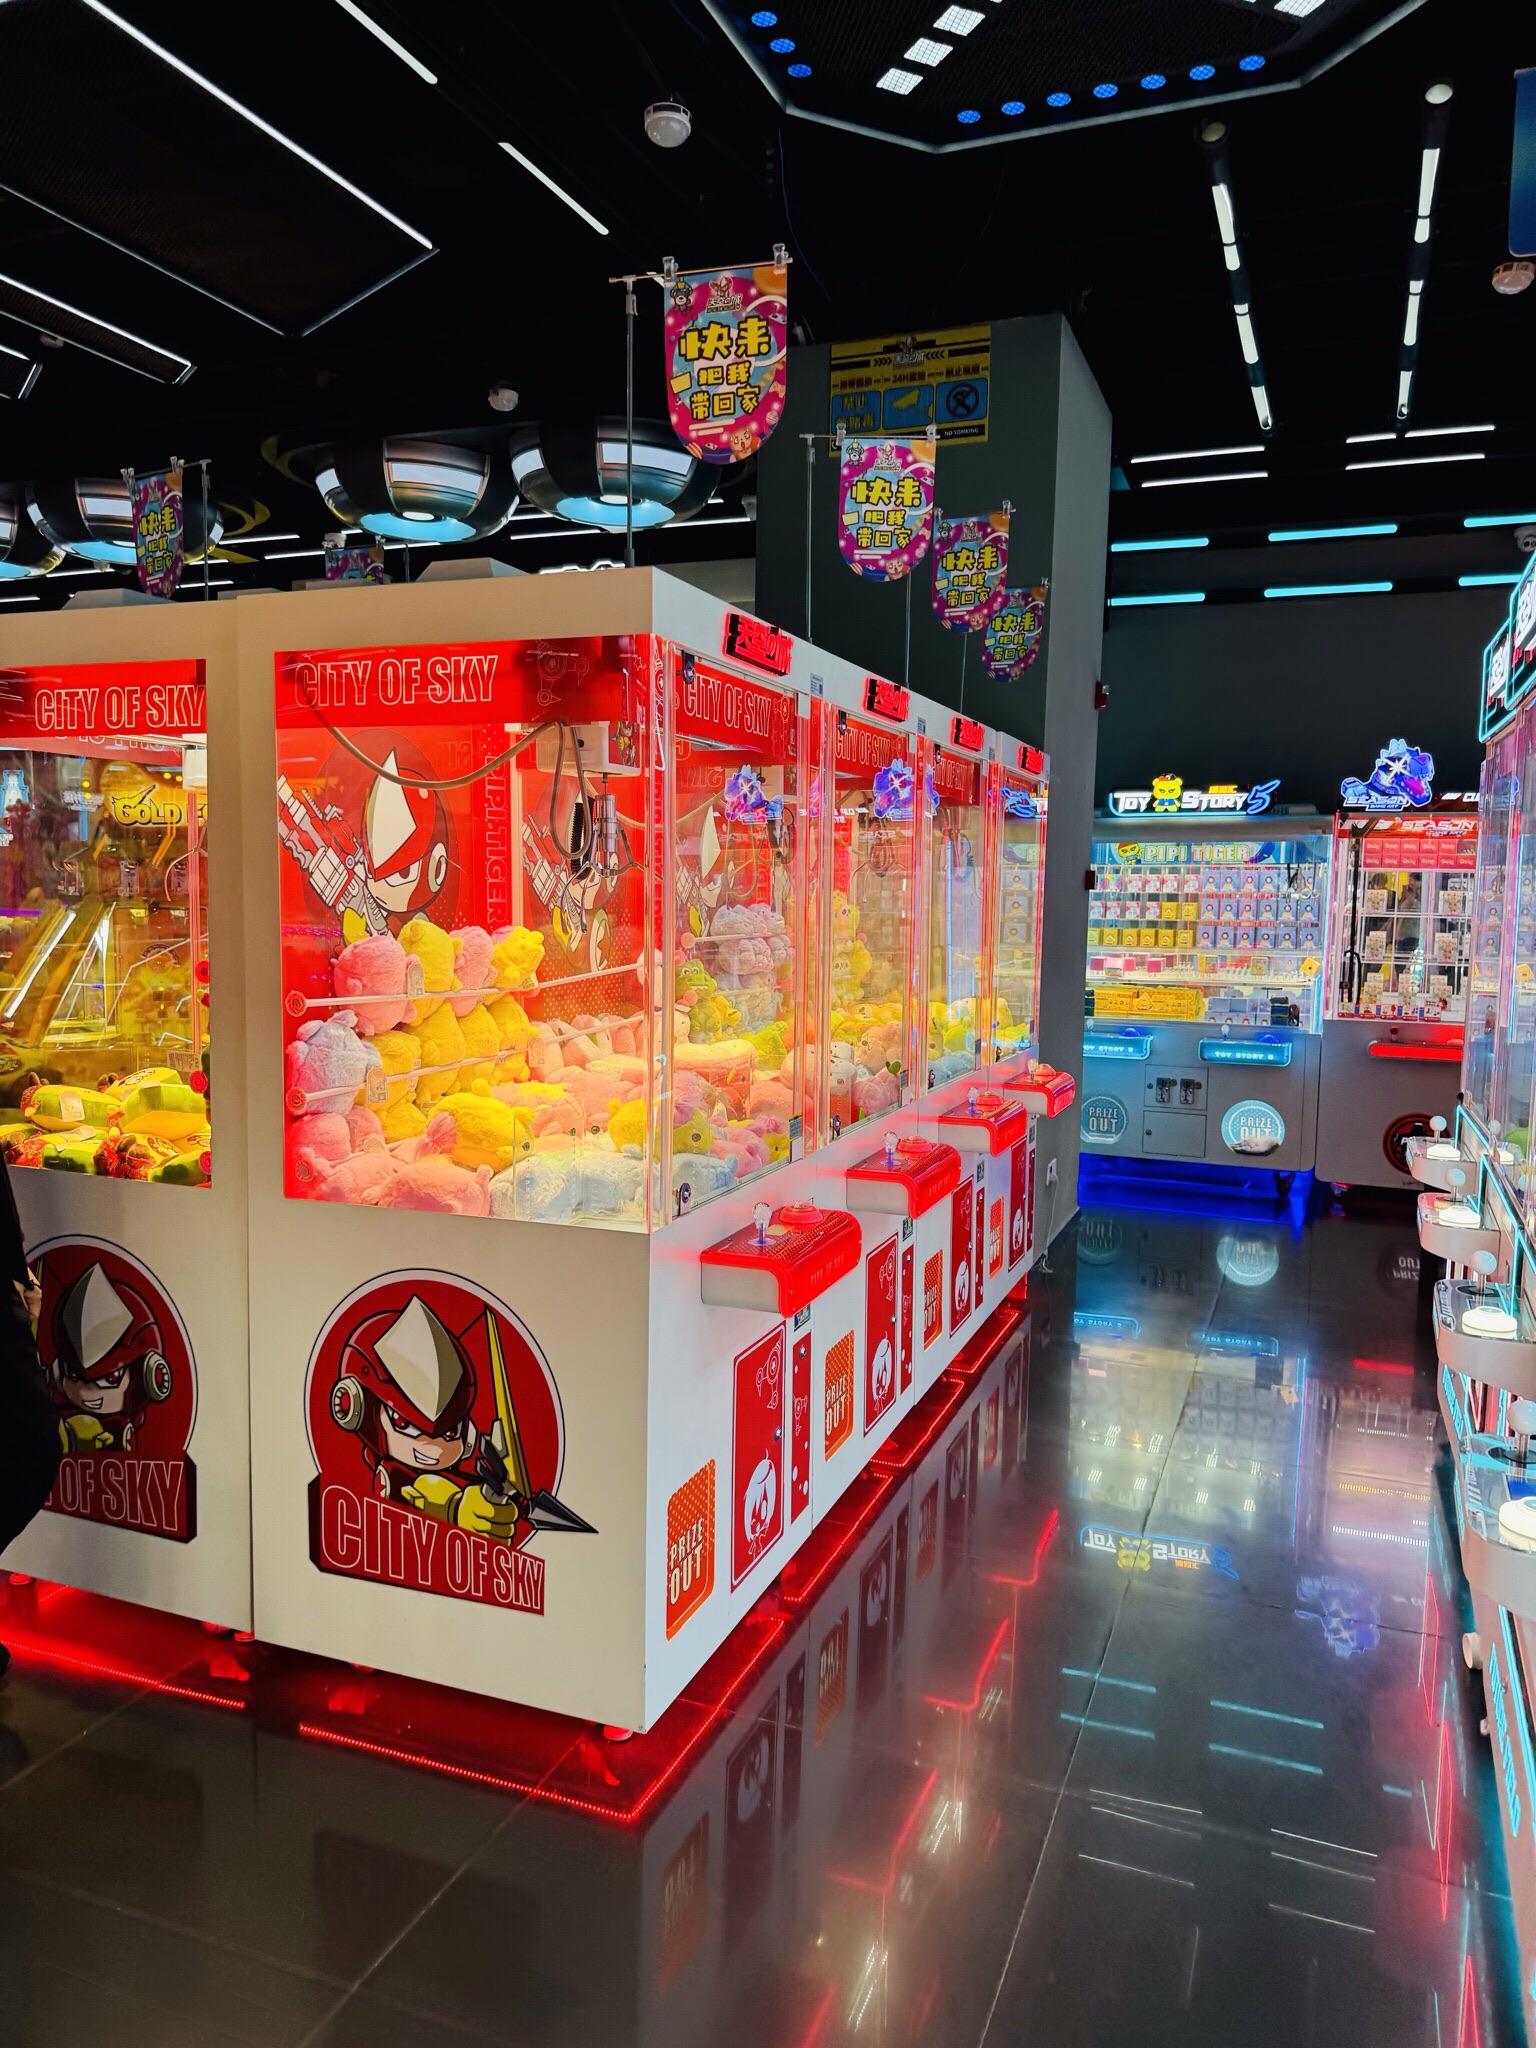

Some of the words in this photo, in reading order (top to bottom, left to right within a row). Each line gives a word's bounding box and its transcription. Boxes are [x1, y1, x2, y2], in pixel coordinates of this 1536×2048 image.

[678, 314, 771, 361] 快来
[697, 360, 752, 386] 把我
[690, 384, 760, 421] 带回家
[850, 476, 922, 507] 快来
[864, 510, 906, 526] 把我
[857, 526, 912, 549] 带回家
[942, 544, 999, 572] 快来
[952, 571, 987, 587] 把我
[947, 586, 991, 607] 带回家
[991, 611, 1036, 632] 快来
[295, 661, 372, 707] CITY
[379, 658, 421, 706] OF
[427, 655, 498, 704] SKY
[35, 688, 99, 731] CITY
[105, 686, 141, 729] OF
[146, 685, 206, 728] SKY
[683, 673, 722, 723] CITY
[724, 683, 743, 729] OF
[744, 690, 772, 737] SKY
[859, 731, 872, 765] OF
[111, 784, 182, 827] GOLD
[1114, 791, 1152, 813] TOY
[1181, 790, 1249, 812] STORY
[1247, 779, 1281, 815] 5
[1347, 796, 1408, 805] SEASON
[1401, 820, 1475, 831] SEASON
[1144, 844, 1187, 862] PIPI
[1192, 844, 1250, 862] TIGER
[486, 826, 508, 924] TIGER
[1236, 1052, 1264, 1060] STORY
[1089, 1106, 1118, 1117] PRIZE
[1089, 1118, 1118, 1132] OUT
[1240, 1116, 1272, 1127] PRIZE
[1240, 1126, 1272, 1140] OUT
[826, 1374, 847, 1409] PRIZE
[826, 1393, 846, 1436] OUT
[59, 1458, 94, 1514] OF
[100, 1459, 184, 1531] SKY
[321, 1485, 438, 1586] CITY
[445, 1529, 488, 1597] OF
[493, 1545, 544, 1610] SKY
[670, 1517, 704, 1571] PRIZE
[669, 1544, 703, 1605] OUT
